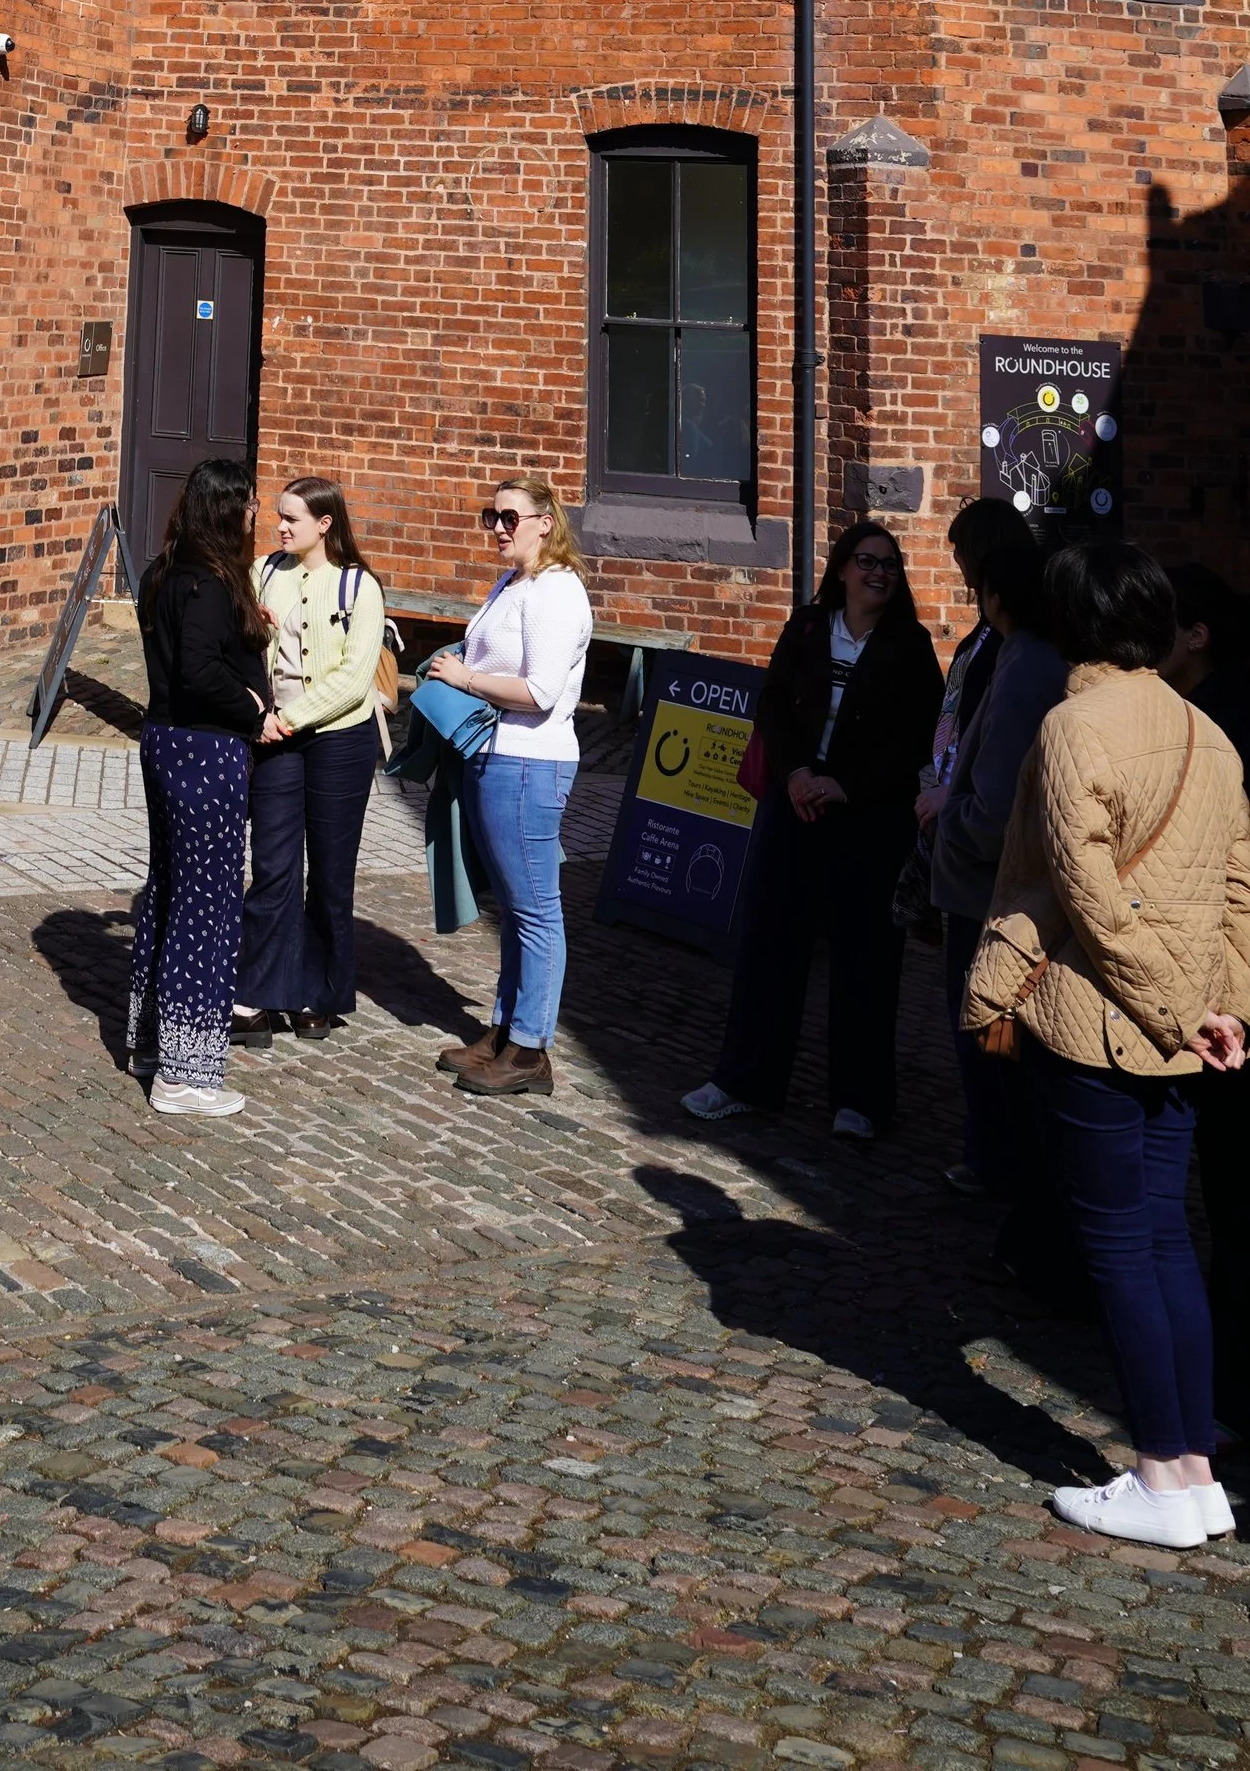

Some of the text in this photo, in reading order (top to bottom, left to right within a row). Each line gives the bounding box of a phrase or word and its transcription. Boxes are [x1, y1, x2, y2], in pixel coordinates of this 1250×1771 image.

[1023, 343, 1083, 356] Welcome to the
[995, 356, 1111, 378] ROUNDHOUSE
[690, 681, 749, 714] OPEN
[706, 723, 749, 741] ROUNDHOU
[688, 779, 701, 789] Tours
[647, 818, 680, 835] Ristorante
[659, 837, 680, 850] Arena
